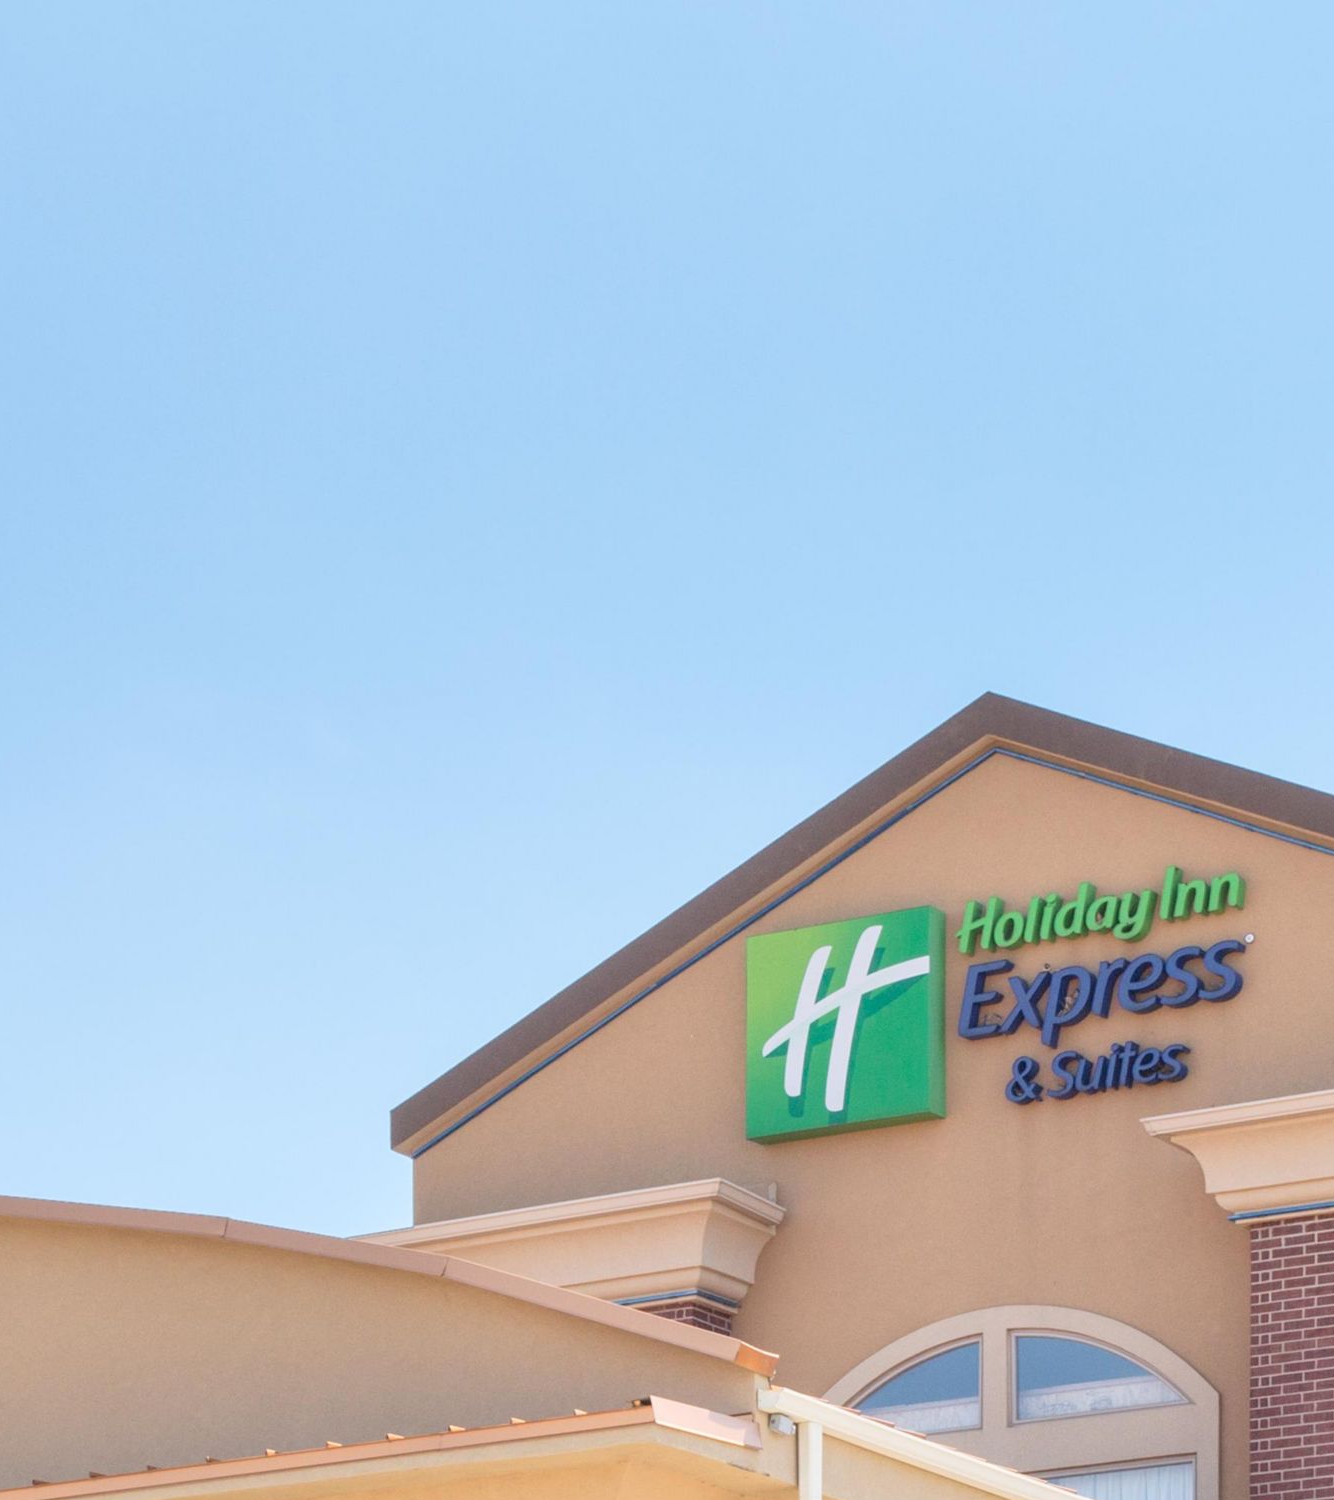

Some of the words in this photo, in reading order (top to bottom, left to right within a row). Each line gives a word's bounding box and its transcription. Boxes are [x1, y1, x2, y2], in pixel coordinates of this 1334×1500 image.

[955, 882, 1158, 956] Holiday
[1159, 865, 1246, 921] Inn
[957, 939, 1246, 1049] Express
[1005, 1055, 1043, 1104] &
[1047, 1040, 1191, 1099] Suites
